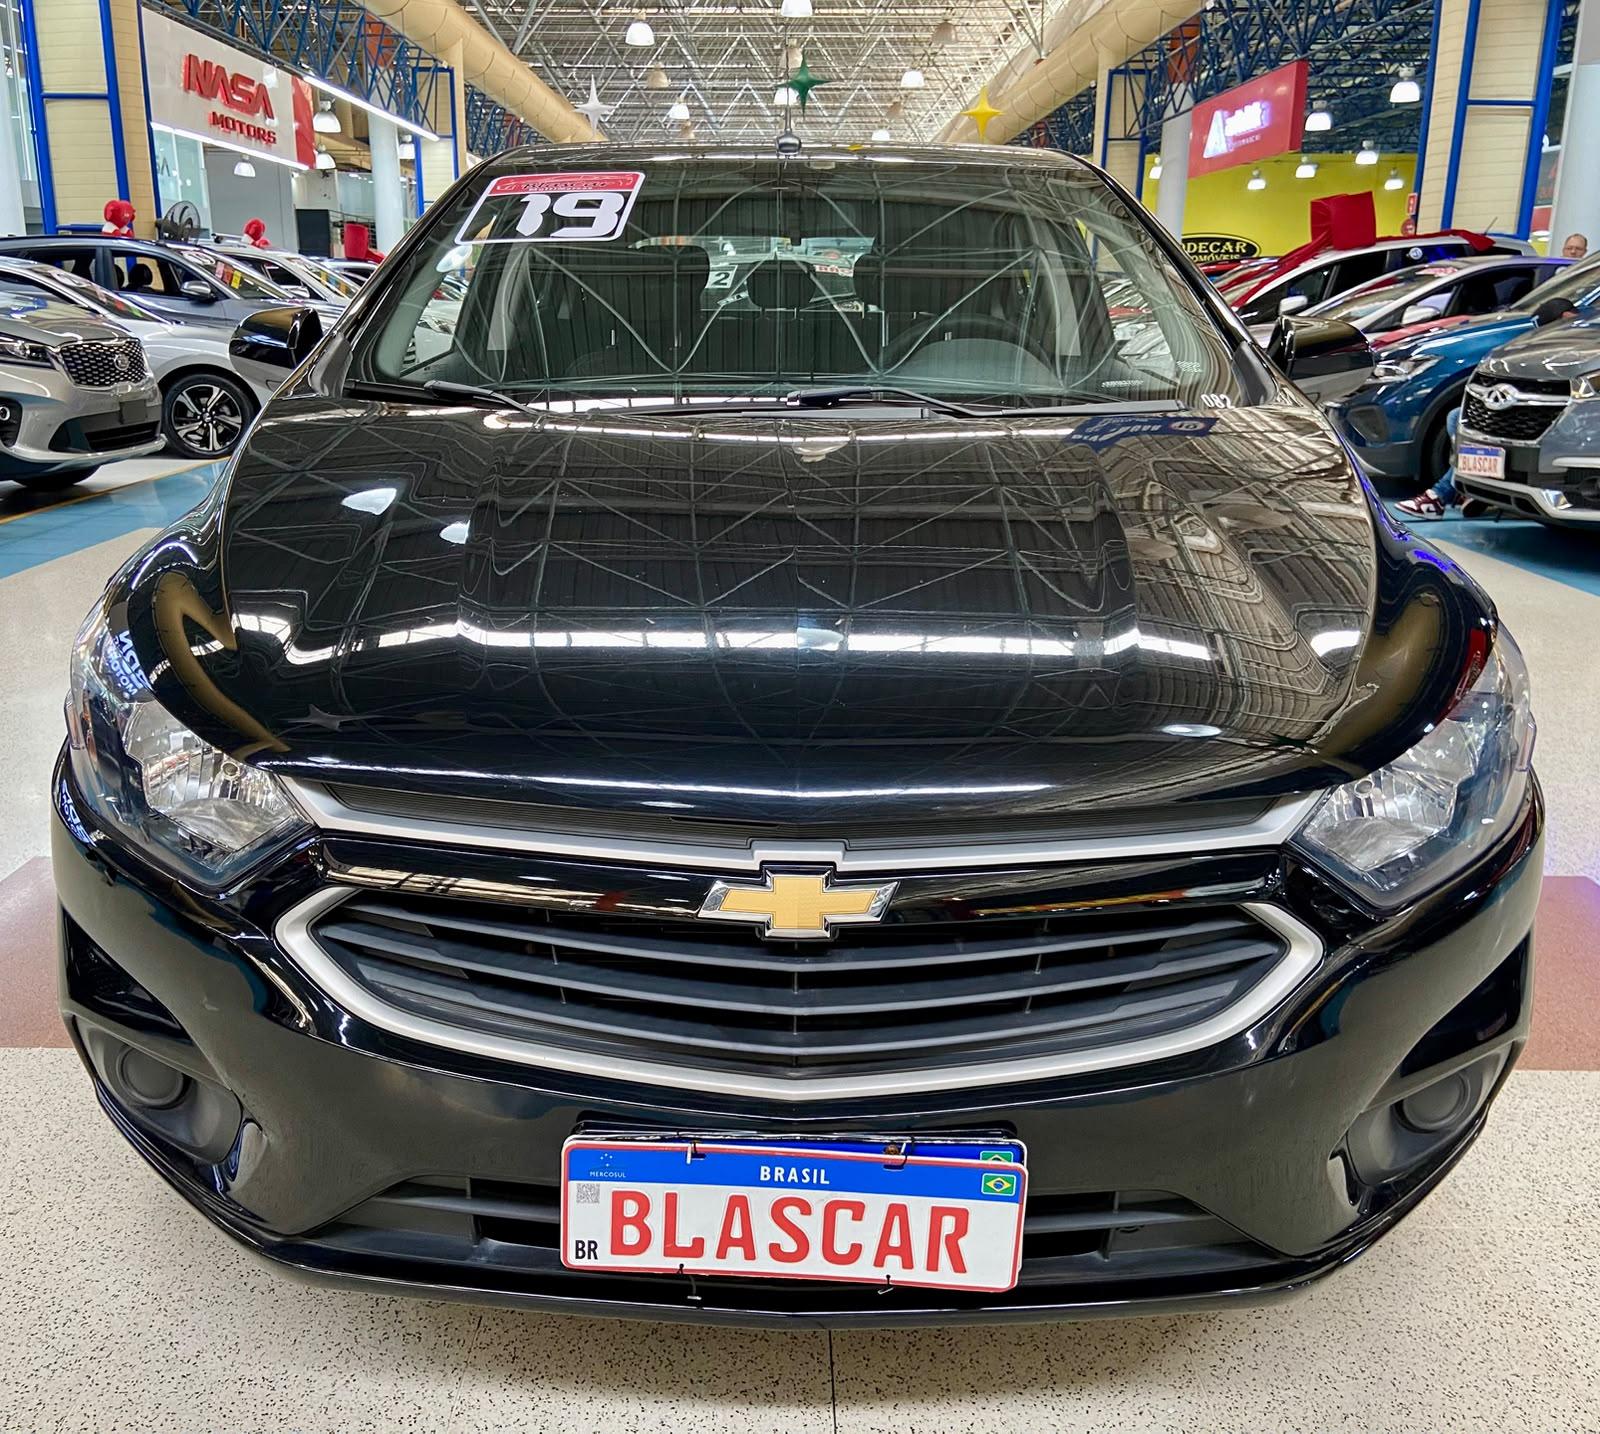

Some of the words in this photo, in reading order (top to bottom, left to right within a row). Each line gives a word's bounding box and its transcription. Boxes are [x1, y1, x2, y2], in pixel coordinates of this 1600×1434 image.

[183, 54, 275, 120] NASA
[208, 111, 278, 147] MOTORS
[515, 192, 626, 238] 19
[1200, 393, 1236, 410] 082
[1462, 456, 1498, 473] BLASCAR
[589, 1170, 627, 1179] MERCOSUL
[759, 1165, 830, 1185] BRASIL
[610, 1189, 970, 1275] BLASCAR
[574, 1239, 599, 1261] BR
